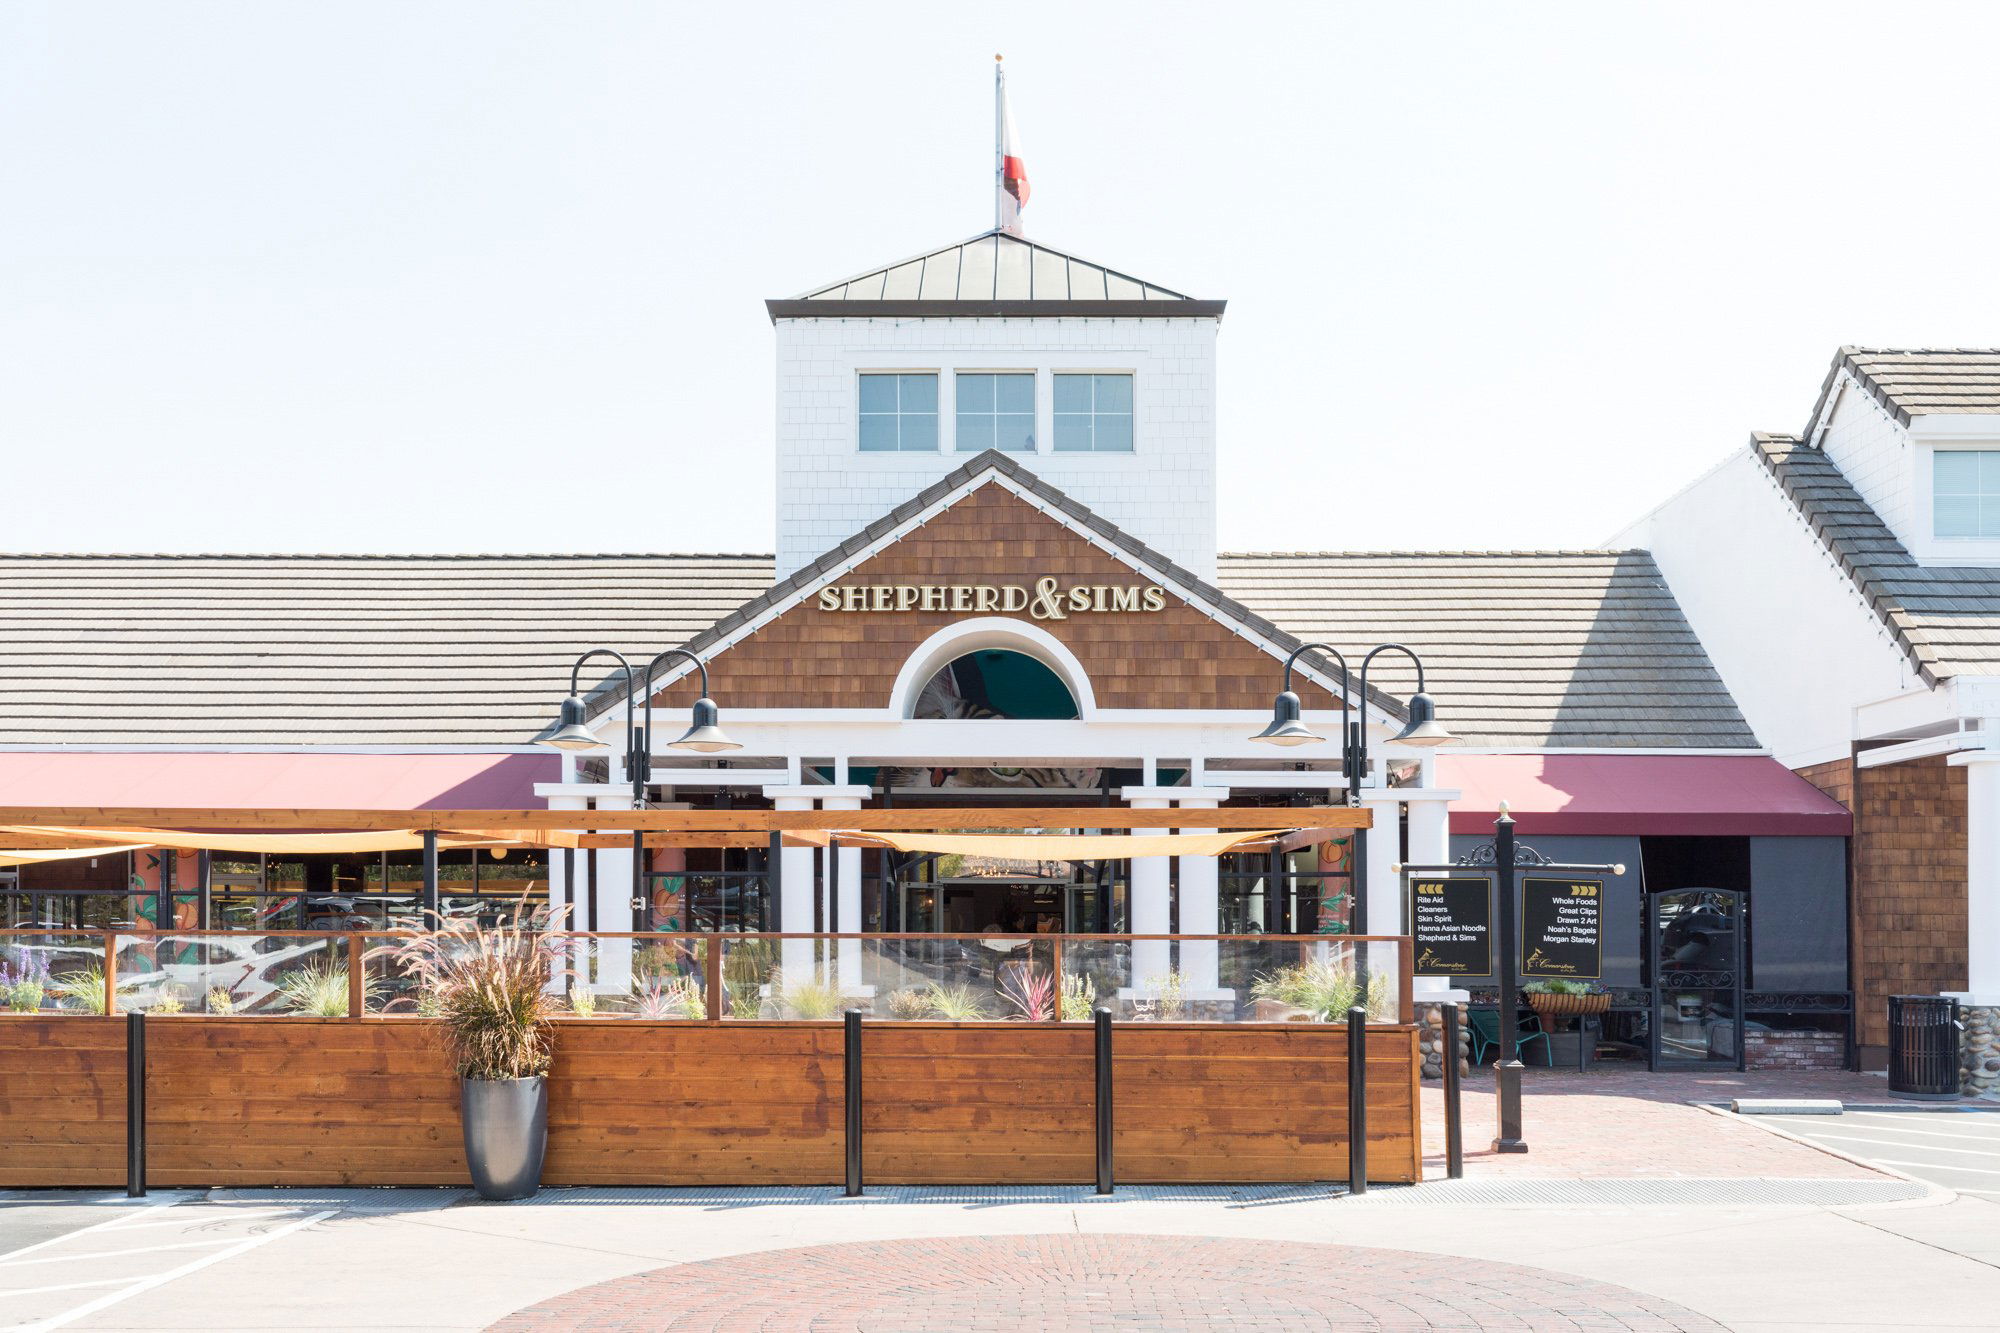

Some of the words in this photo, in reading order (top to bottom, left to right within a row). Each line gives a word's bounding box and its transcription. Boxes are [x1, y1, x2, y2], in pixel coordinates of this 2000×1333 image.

[1417, 896, 1432, 904] Rite
[1432, 896, 1444, 904] Aid
[1552, 897, 1575, 905] Whole
[1575, 898, 1598, 906] Foods
[1579, 907, 1598, 916] Clips
[1433, 915, 1452, 924] Spirit
[1556, 916, 1580, 924] Drawn
[1580, 917, 1586, 925] 2
[1586, 917, 1598, 925] Art
[1547, 925, 1572, 933] Noah's
[1573, 926, 1597, 935] Bagels
[1418, 934, 1451, 942] Shepherd
[1543, 935, 1570, 944] Morgan
[1571, 936, 1597, 945] Stanley
